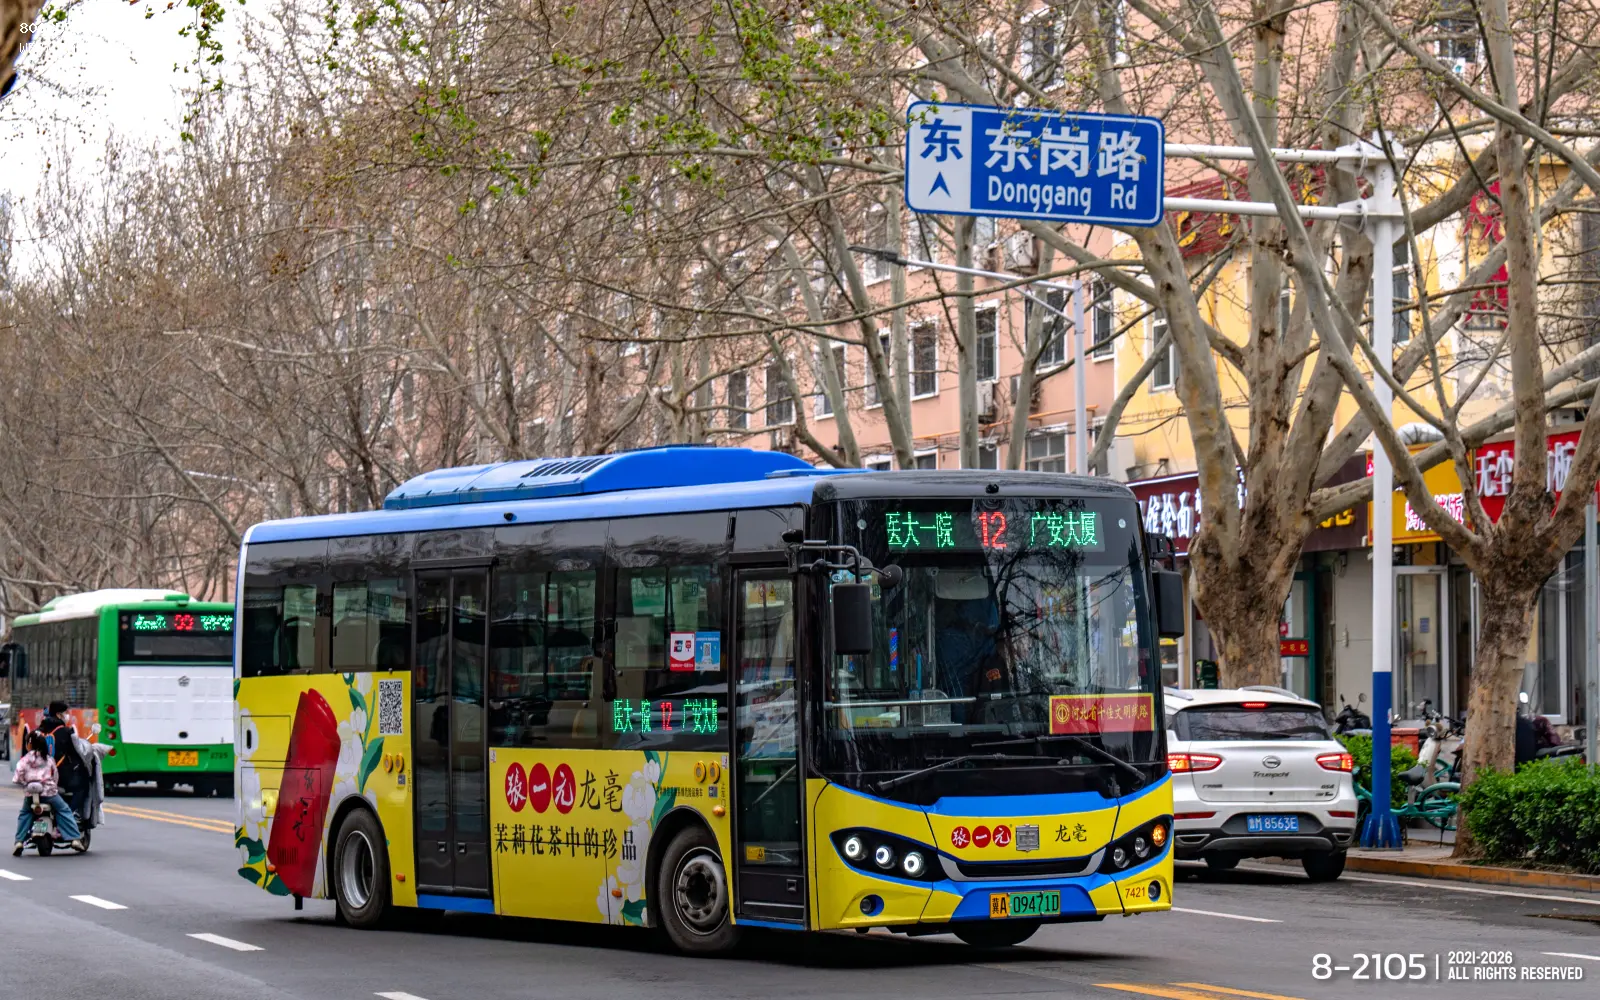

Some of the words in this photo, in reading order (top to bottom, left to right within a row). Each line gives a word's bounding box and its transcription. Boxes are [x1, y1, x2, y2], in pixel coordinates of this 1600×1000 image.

[920, 118, 963, 162] 东
[984, 126, 1142, 182] 东岗路
[988, 175, 1092, 215] Donggang
[1110, 183, 1137, 210] Rd
[978, 511, 1007, 548] 12
[1030, 511, 1098, 547] 广安大厦
[661, 702, 672, 731] 12
[579, 768, 624, 813] 龙毫
[494, 822, 637, 861] 茉莉花茶中的珍品
[1054, 823, 1088, 843] 龙毫
[1125, 887, 1145, 898] 7421
